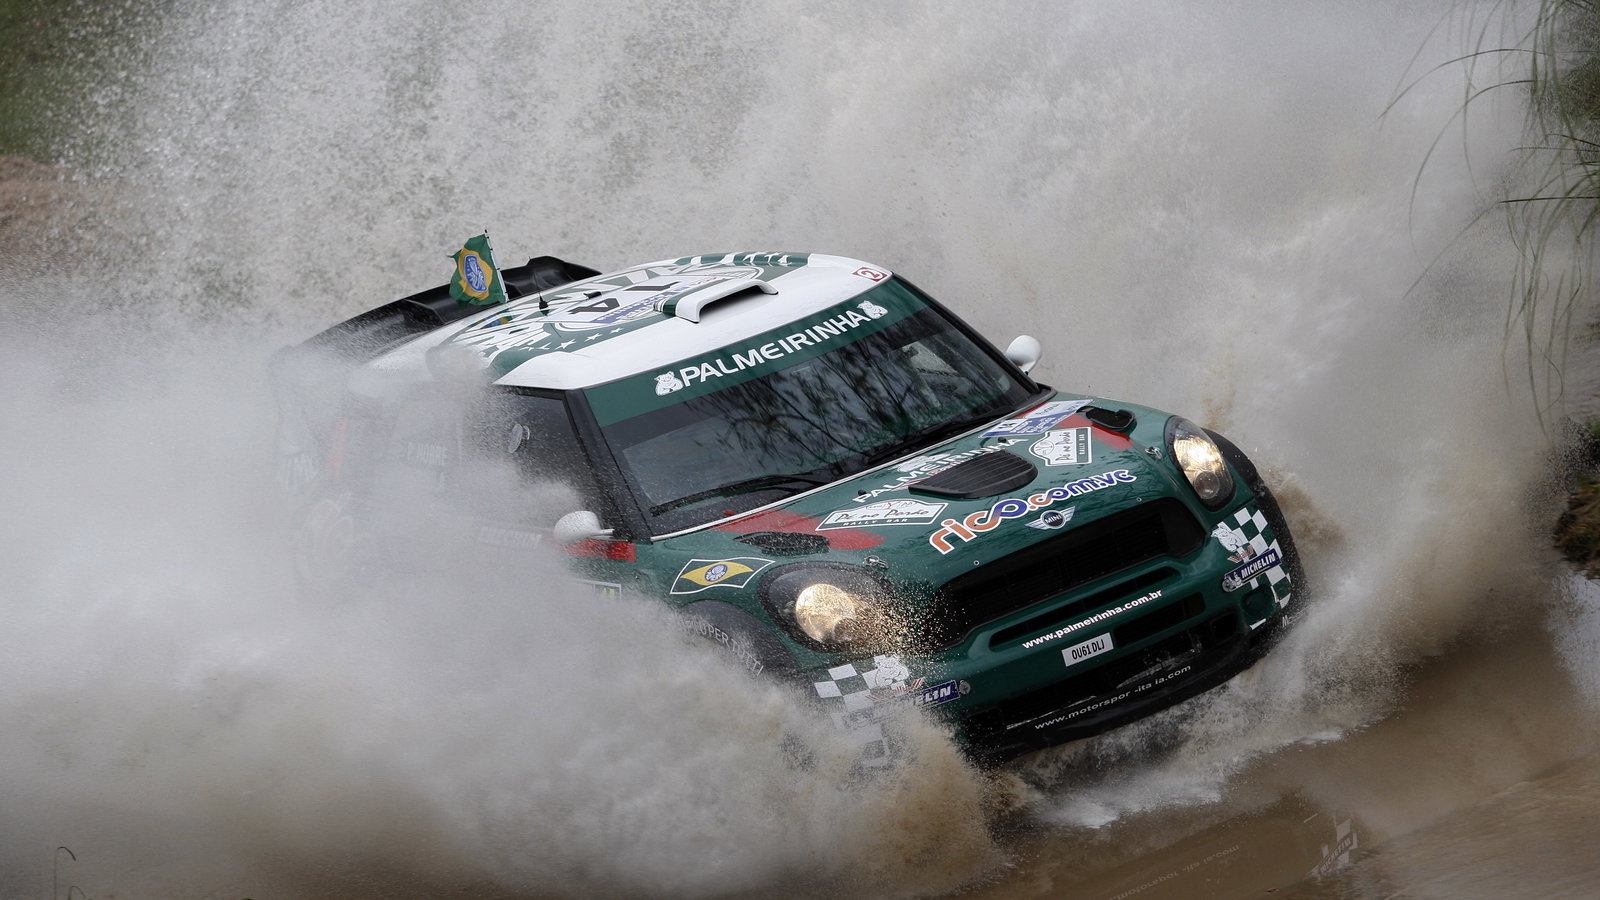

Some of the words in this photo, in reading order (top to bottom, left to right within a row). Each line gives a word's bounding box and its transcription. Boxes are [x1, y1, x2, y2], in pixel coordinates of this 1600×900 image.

[681, 310, 871, 388] PALMEIRINHA
[853, 438, 1028, 502] PALMEIRINHA
[1044, 514, 1063, 524] MINI
[1240, 552, 1276, 579] MICHELIN
[1022, 589, 1163, 650] www.palmeirinha.com.br
[1071, 644, 1092, 660] OU61
[1091, 639, 1105, 653] DLJ
